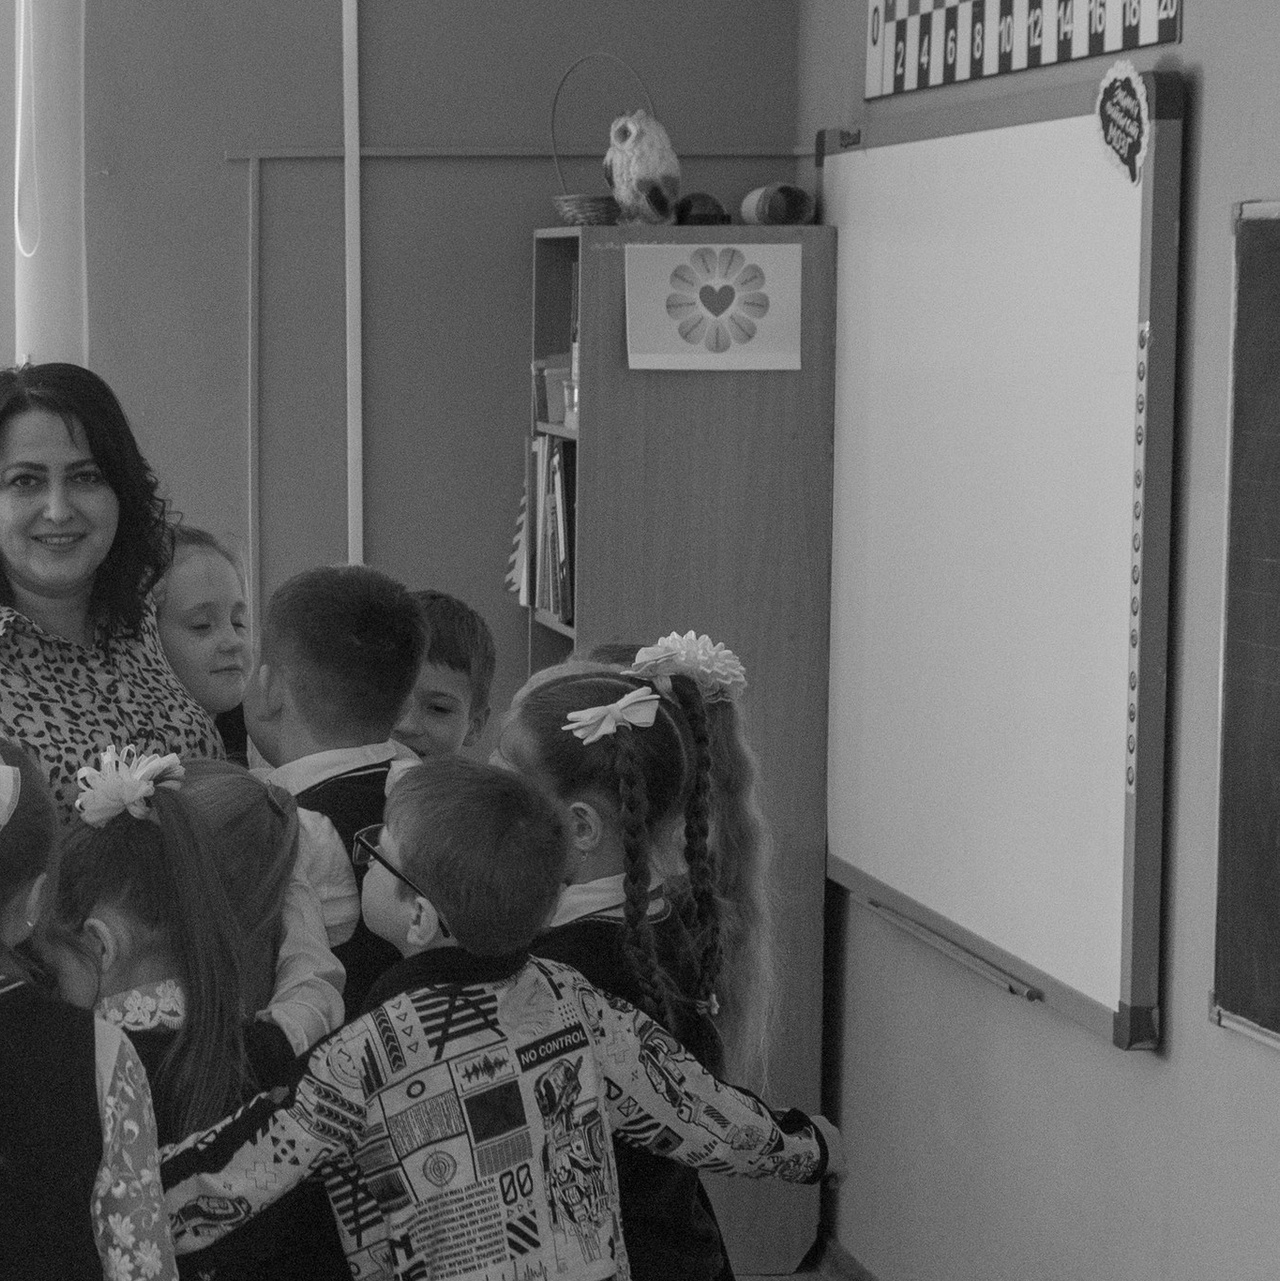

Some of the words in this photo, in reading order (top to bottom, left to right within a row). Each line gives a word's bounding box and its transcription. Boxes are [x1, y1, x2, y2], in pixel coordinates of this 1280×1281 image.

[872, 6, 880, 47] 0
[895, 41, 904, 75] 2
[920, 34, 929, 71] 4
[947, 28, 956, 65] 6
[973, 22, 983, 60] 8
[999, 16, 1013, 54] 10
[1027, 9, 1042, 47] 12
[1058, 0, 1073, 41] 14
[520, 1049, 537, 1065] NO
[538, 1030, 586, 1057] CONTROL
[499, 1162, 534, 1206] 00
